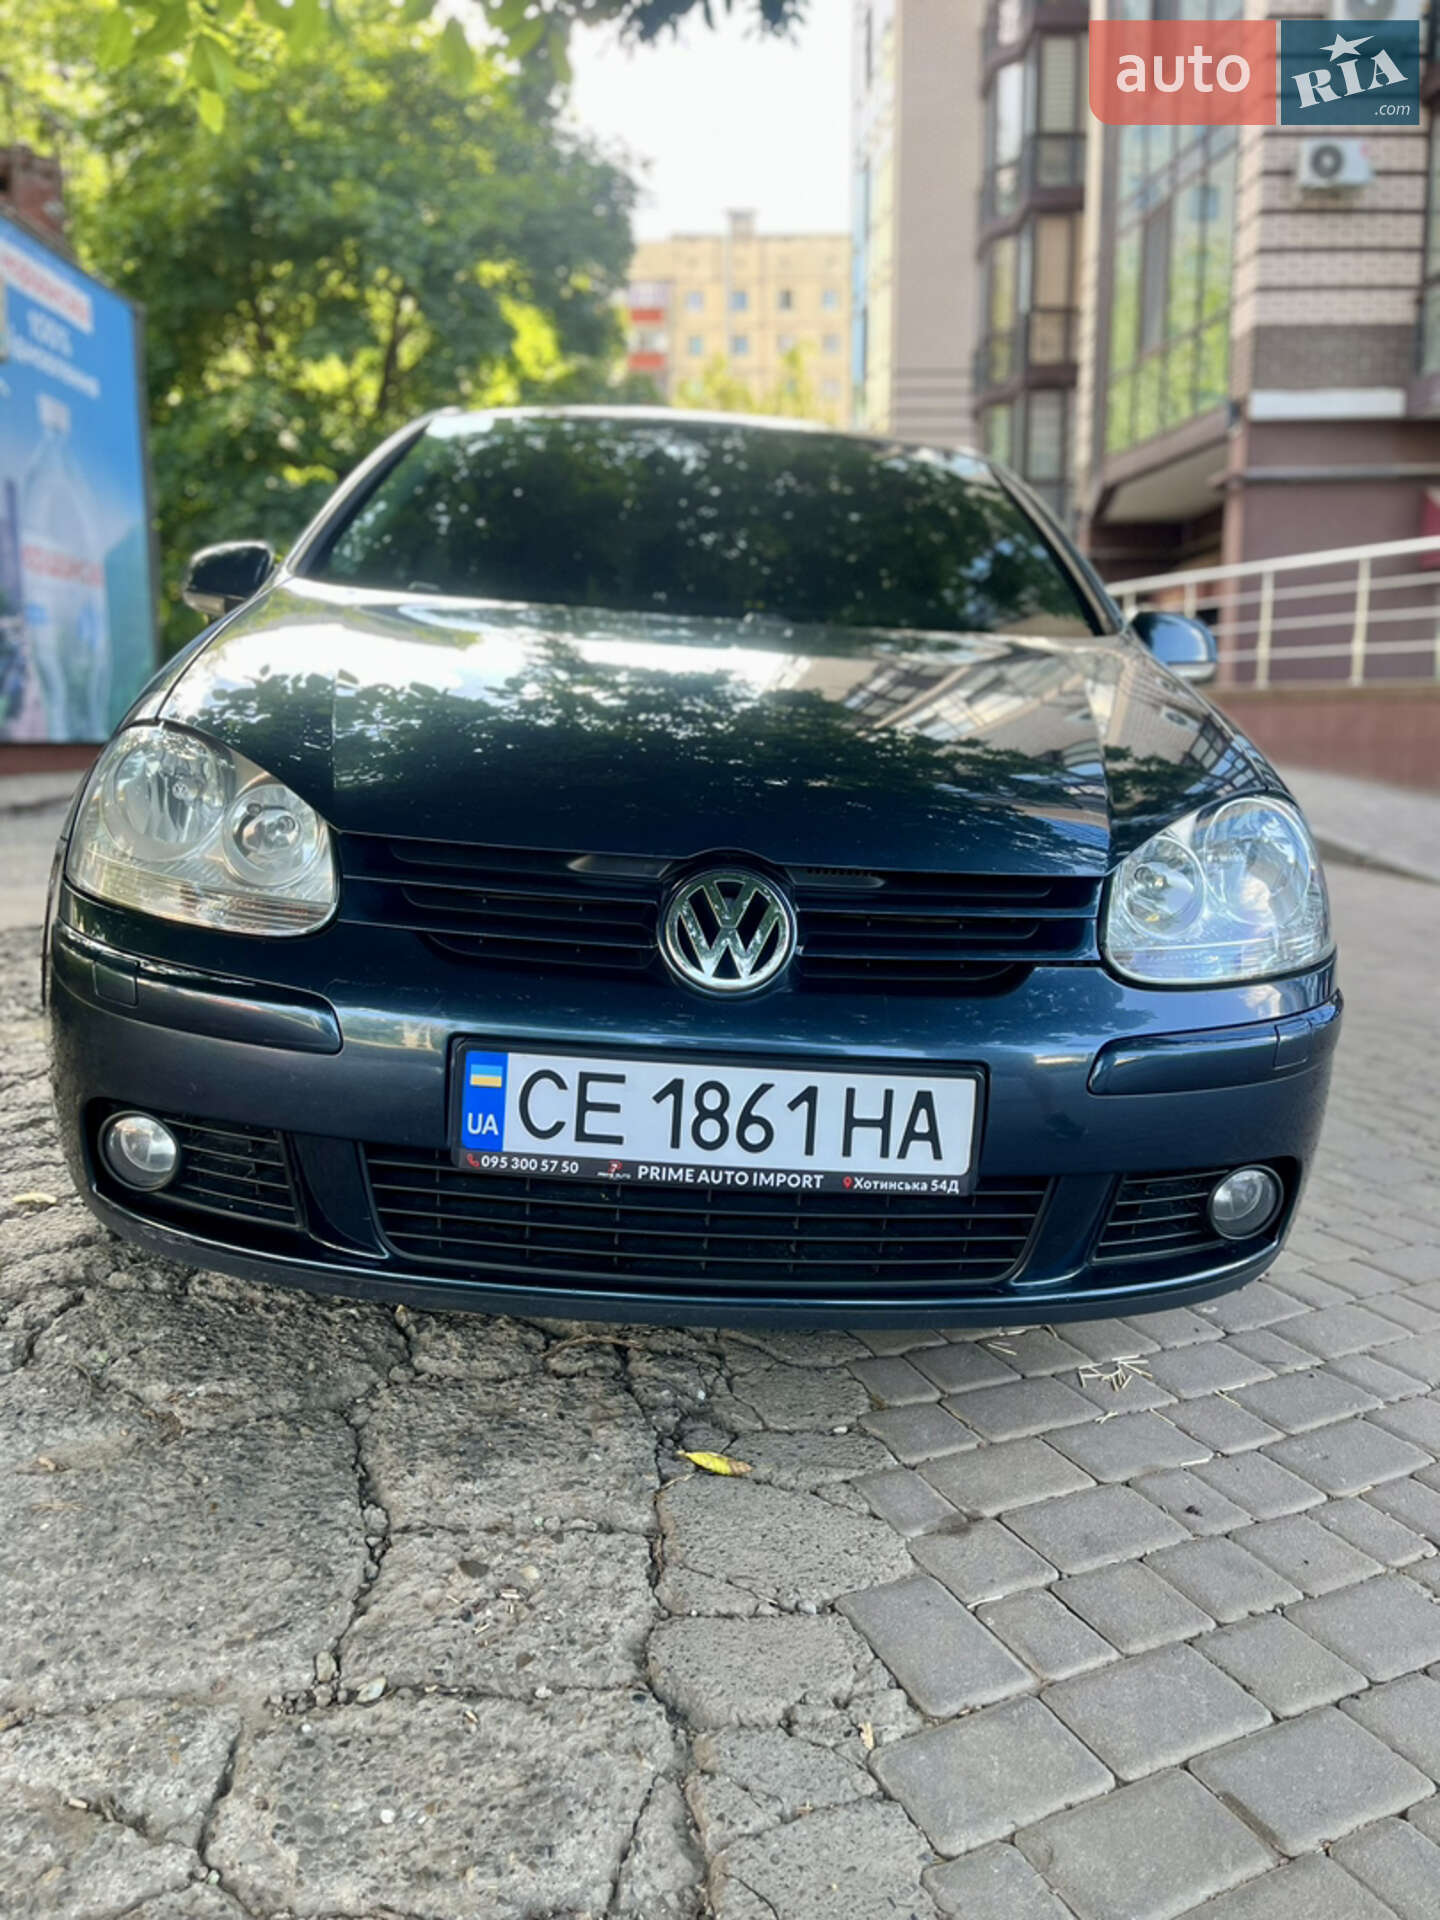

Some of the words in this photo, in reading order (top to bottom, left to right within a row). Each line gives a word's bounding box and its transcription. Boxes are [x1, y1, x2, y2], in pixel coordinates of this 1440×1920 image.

[467, 1112, 499, 1136] UA
[518, 1068, 626, 1146] CE
[651, 1077, 818, 1157] 1861
[841, 1086, 943, 1161] HA
[481, 1155, 508, 1169] 095
[511, 1157, 538, 1171] 300
[541, 1159, 557, 1172] 57
[560, 1160, 579, 1174] 50
[637, 1165, 694, 1183] PRIME
[697, 1168, 749, 1186] AUTO
[752, 1173, 824, 1189] IMPORT
[853, 1177, 927, 1192] Хотинська
[931, 1179, 959, 1194] 54Д
